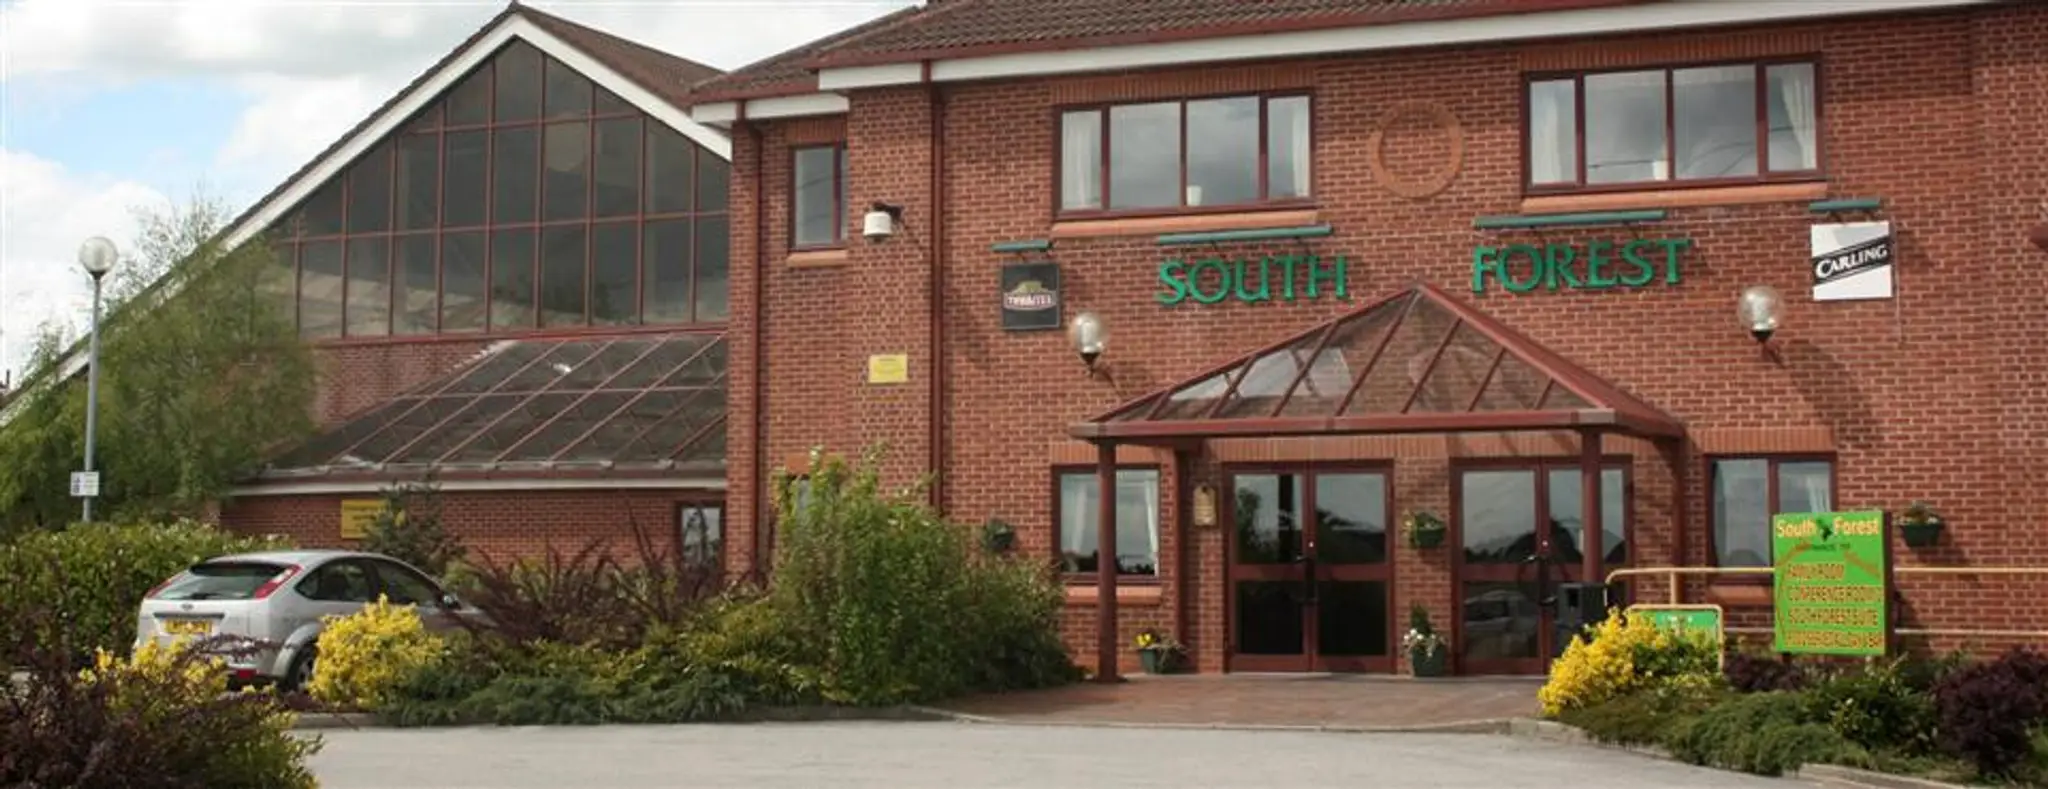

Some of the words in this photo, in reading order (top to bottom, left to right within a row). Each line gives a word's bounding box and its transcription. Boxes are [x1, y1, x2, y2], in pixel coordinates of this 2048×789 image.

[1154, 255, 1348, 304] SOUTH
[1472, 238, 1694, 293] FOREST
[1816, 243, 1888, 279] CARLING
[1776, 518, 1817, 538] South
[1833, 516, 1879, 536] Forest
